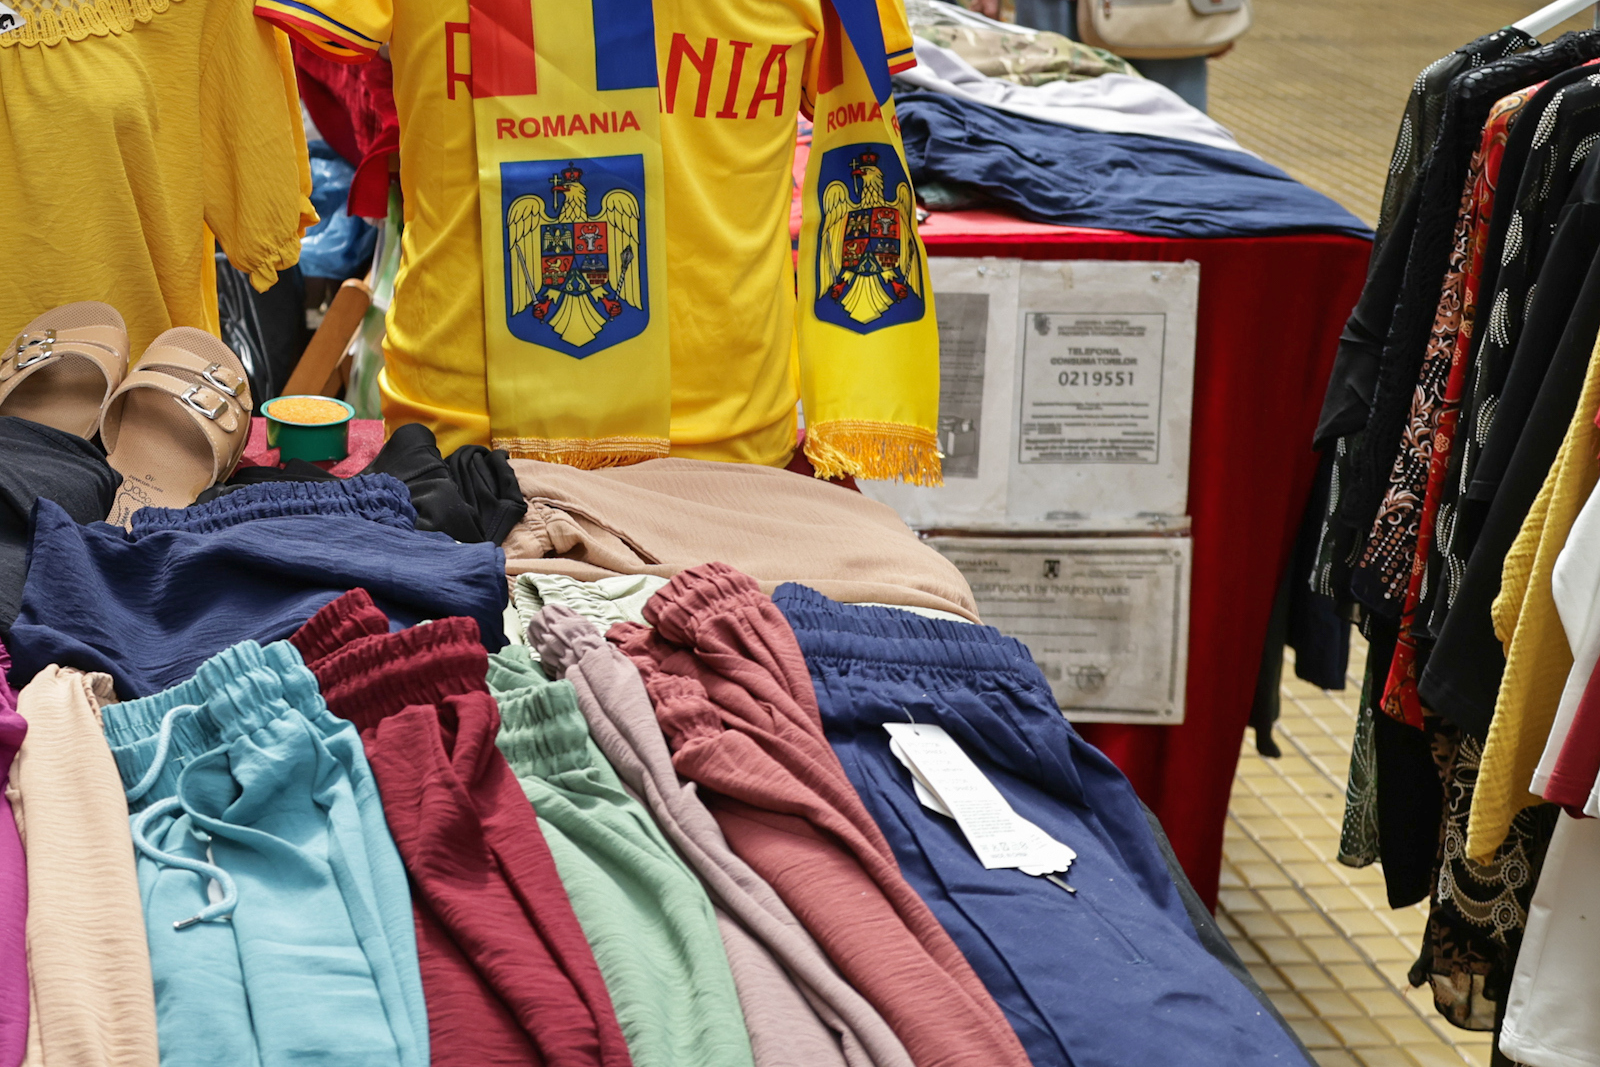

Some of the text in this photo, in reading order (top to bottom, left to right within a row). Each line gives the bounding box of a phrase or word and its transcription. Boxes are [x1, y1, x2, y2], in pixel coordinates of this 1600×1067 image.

[495, 110, 641, 140] ROMANIA
[1067, 347, 1122, 356] TELEFONUL
[1058, 371, 1135, 387] 0219551
